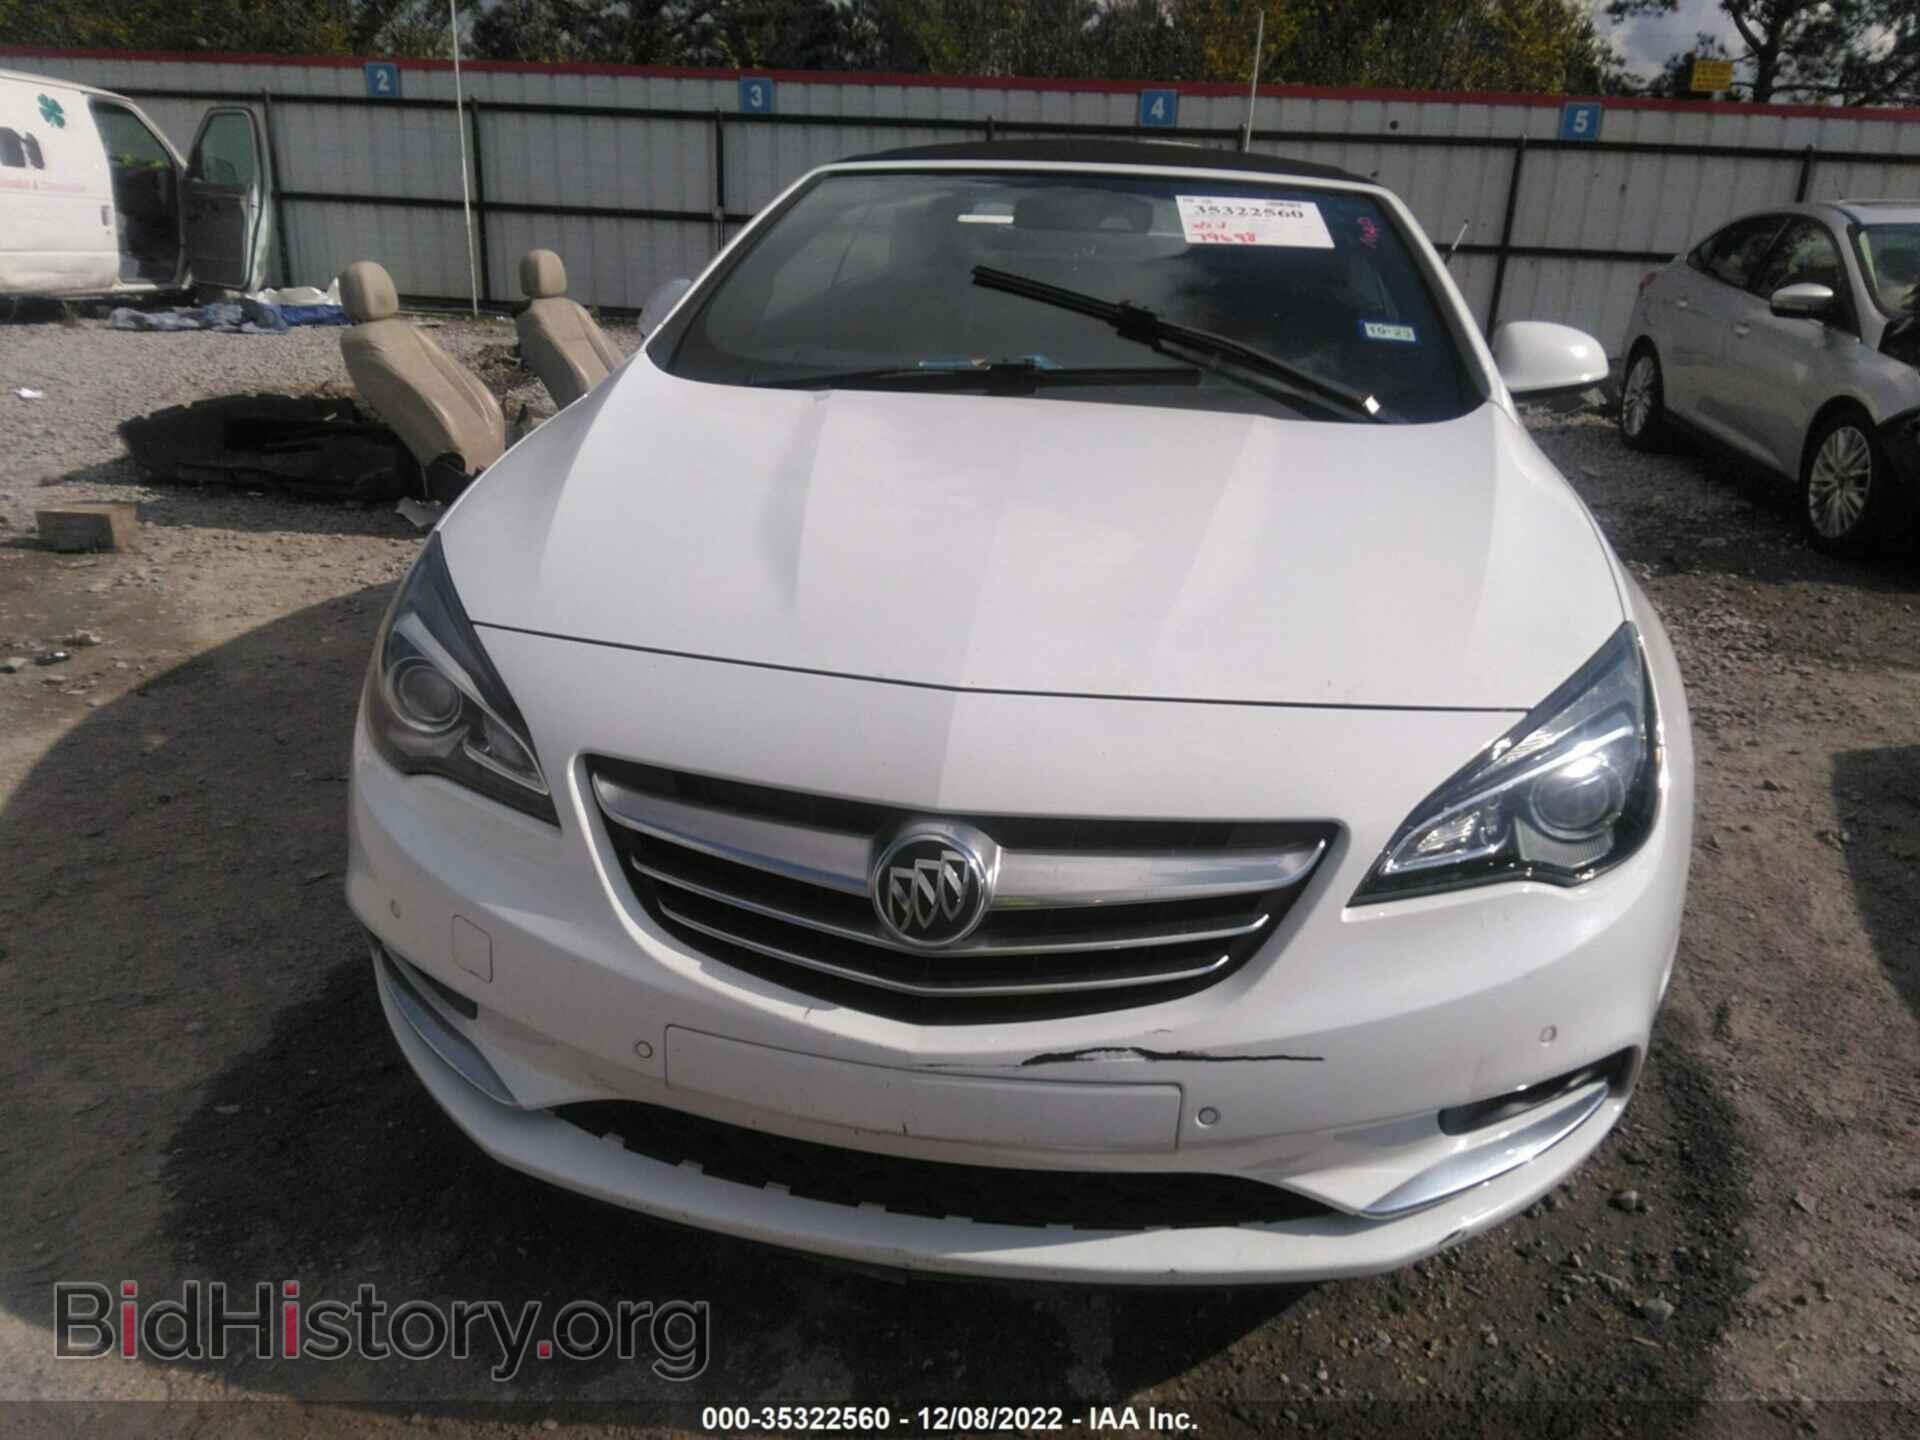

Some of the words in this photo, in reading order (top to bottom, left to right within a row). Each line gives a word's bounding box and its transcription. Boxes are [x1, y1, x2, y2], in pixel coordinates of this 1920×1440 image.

[376, 70, 390, 91] 2
[750, 85, 763, 107] 3
[1151, 96, 1168, 120] 4
[1574, 110, 1589, 133] 5
[1193, 204, 1305, 219] 35322560
